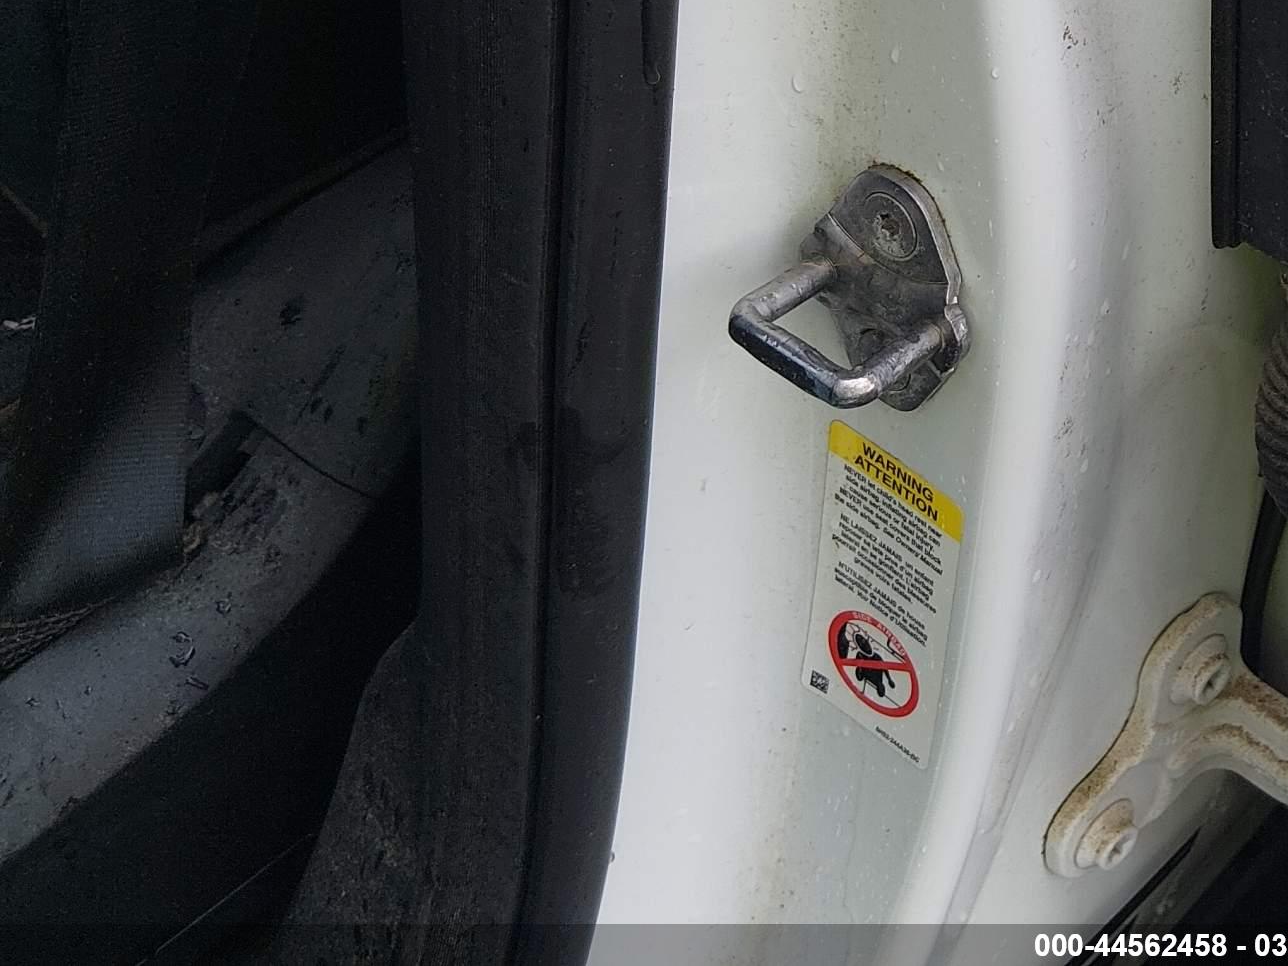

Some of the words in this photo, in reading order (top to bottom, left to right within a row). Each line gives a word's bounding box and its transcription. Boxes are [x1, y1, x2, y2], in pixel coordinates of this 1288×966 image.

[844, 463, 866, 484] NEVER
[863, 442, 935, 503] WARNING
[839, 486, 861, 506] NEVER
[855, 457, 939, 522] ATTENTION
[908, 518, 927, 538] airbag
[928, 534, 940, 547] can
[878, 540, 902, 562] JAMAIS
[873, 585, 896, 608] JAMAIS
